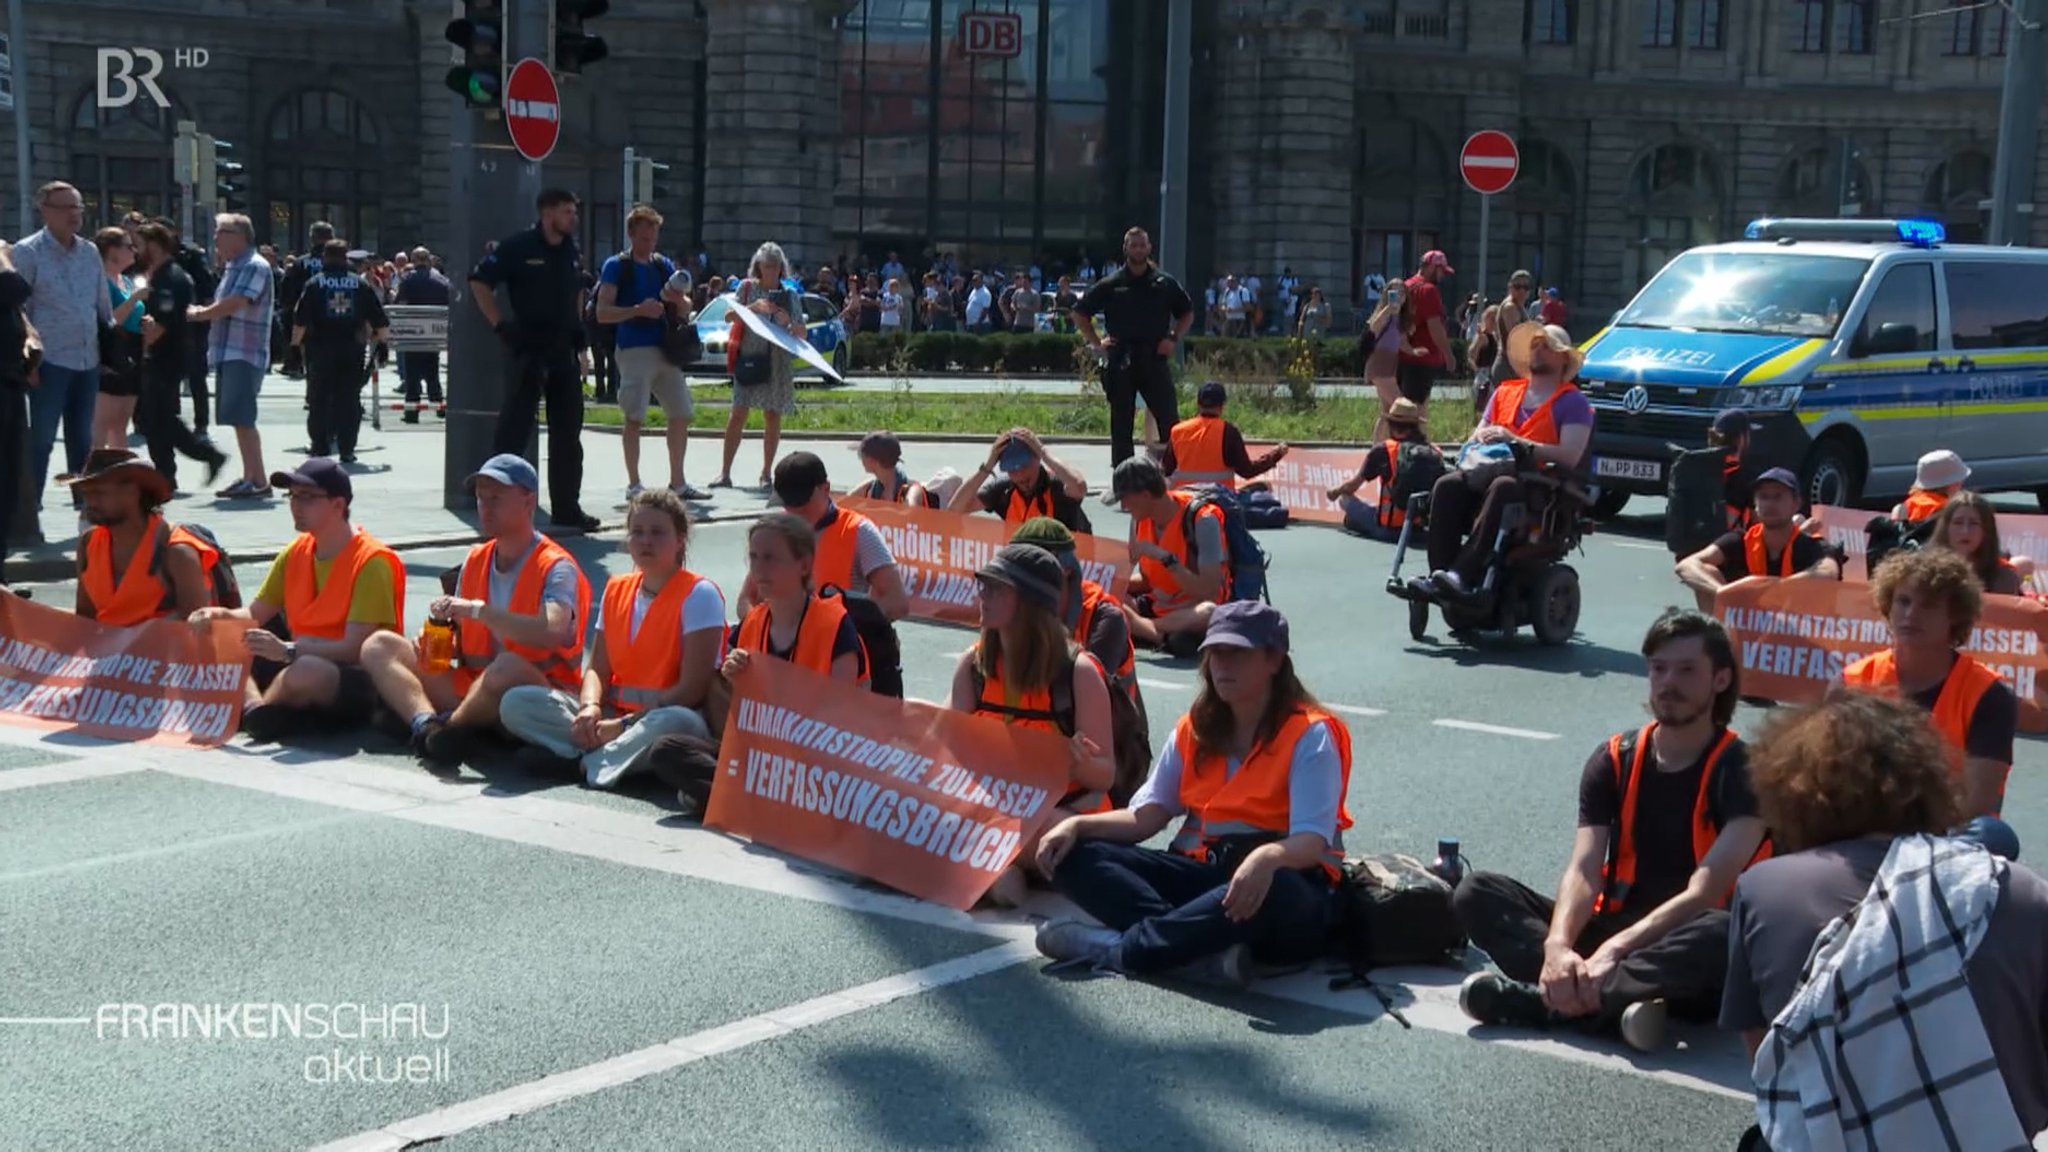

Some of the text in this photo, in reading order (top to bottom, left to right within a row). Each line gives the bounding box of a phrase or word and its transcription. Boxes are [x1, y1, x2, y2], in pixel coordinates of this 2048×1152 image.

[969, 20, 1015, 51] DB
[318, 276, 359, 289] POLIZEI
[1614, 346, 1716, 366] POLIZEI
[880, 522, 944, 566] CHÖNE
[1723, 607, 2038, 657] KLIMAKATASTRO ASSEN
[159, 663, 244, 692] ZULASSEN
[0, 676, 233, 737] ERFASSUNGSBRUCH
[737, 697, 1048, 819] KLIMAKATASTROPHE ZULASSEN
[745, 747, 1022, 873] VERFASSUNGSBRUCH
